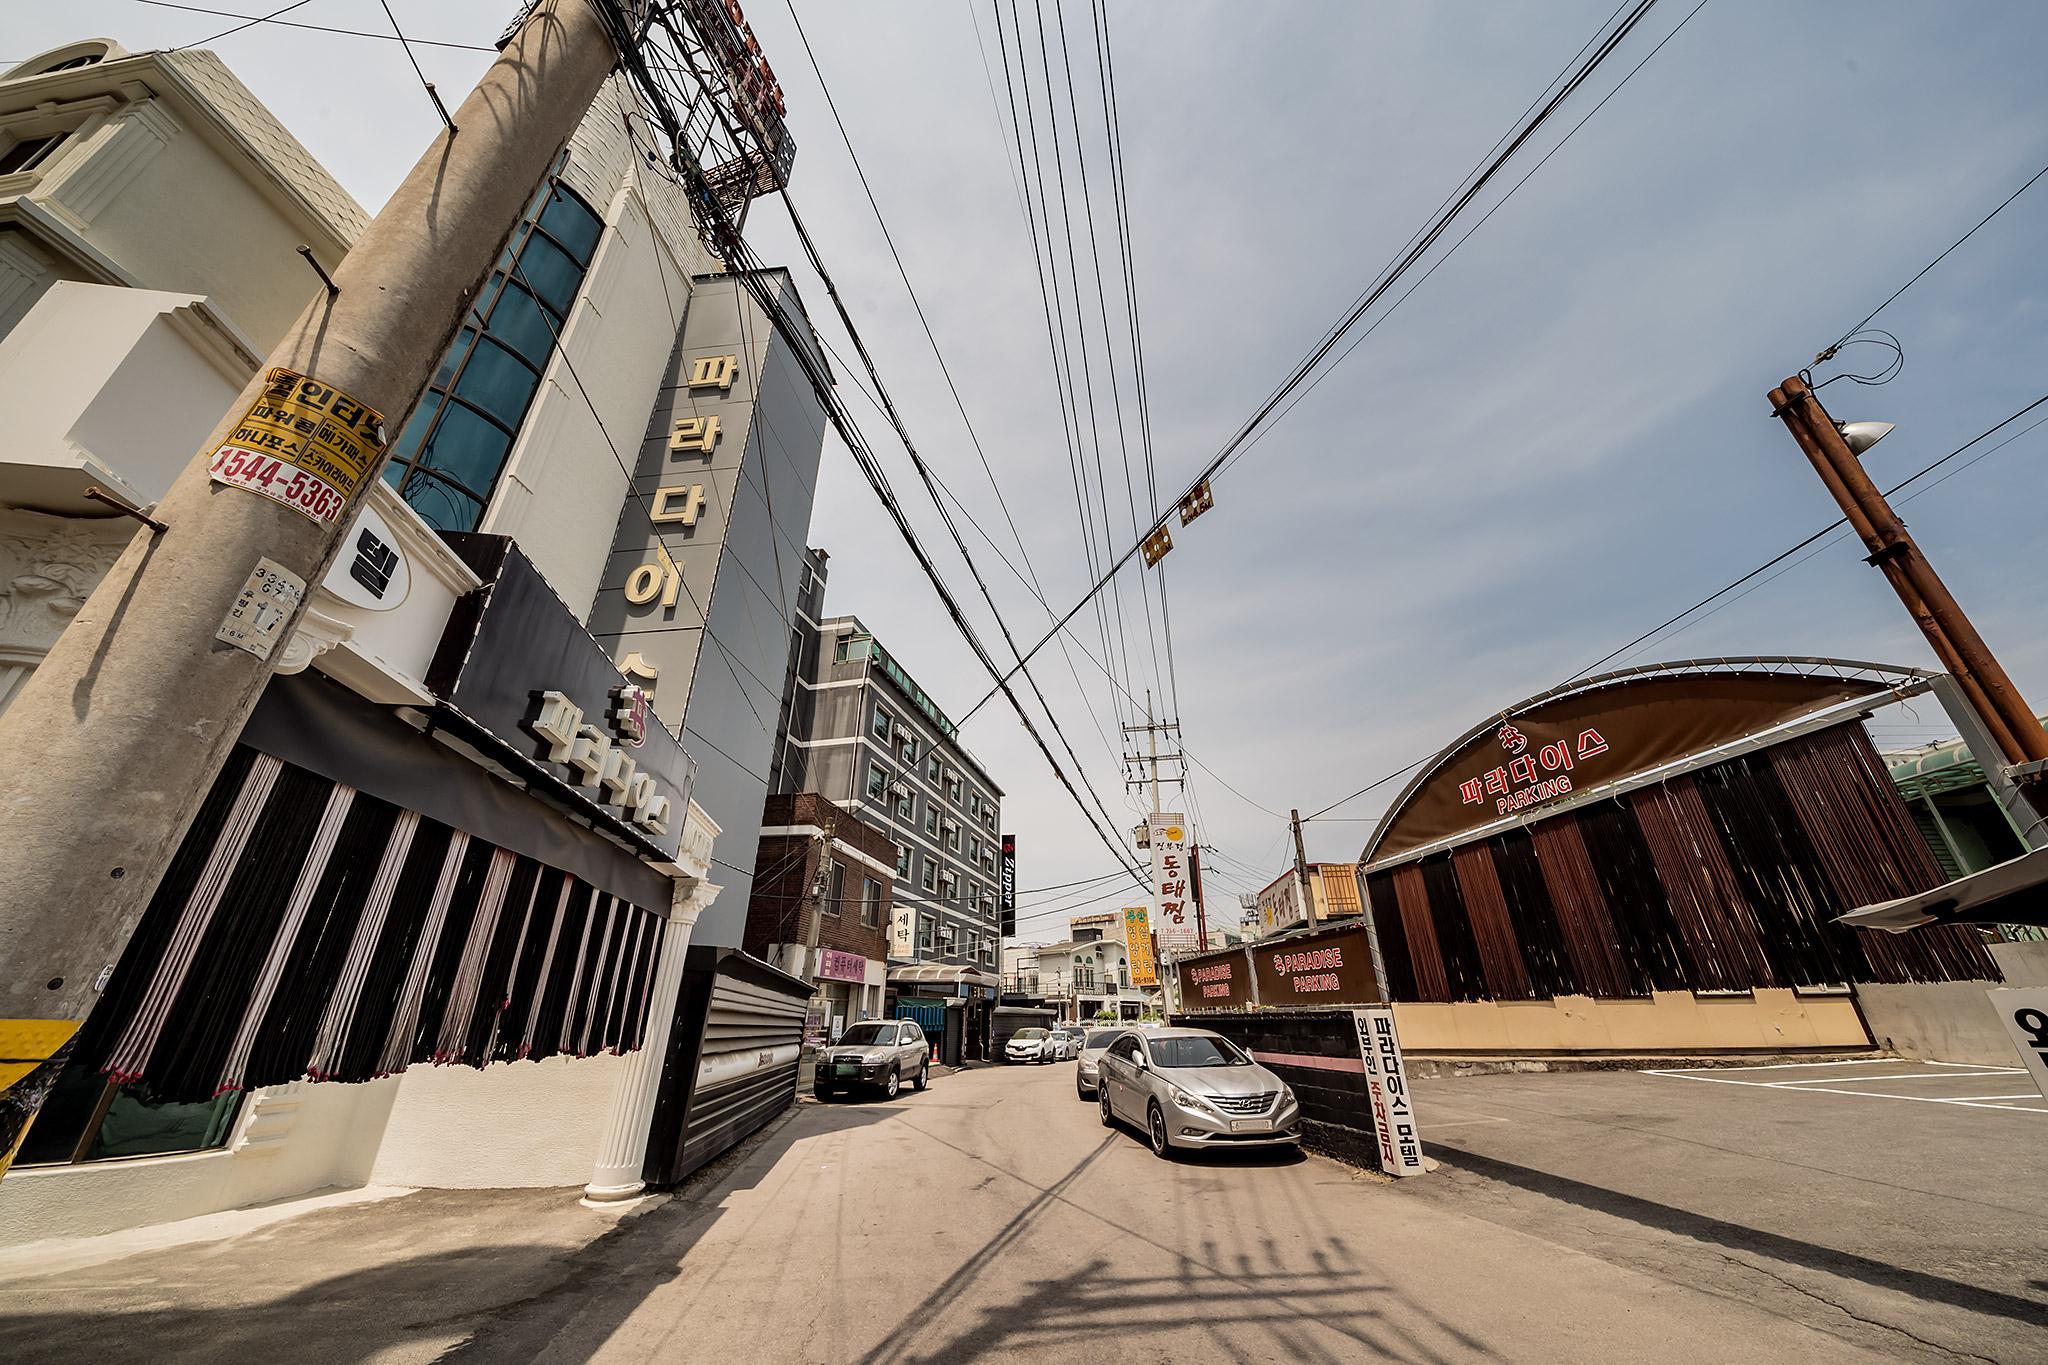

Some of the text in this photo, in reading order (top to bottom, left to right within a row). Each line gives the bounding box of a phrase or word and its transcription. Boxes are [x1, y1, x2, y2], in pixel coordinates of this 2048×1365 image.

[234, 428, 300, 457] 하나포스
[318, 429, 369, 469] 메가패스
[210, 449, 343, 521] 1544-5363
[304, 447, 354, 493] 스카이라이프
[350, 527, 400, 600] 텔
[1459, 728, 1609, 805] 파라다이스
[1496, 774, 1573, 815] PARKING
[1002, 857, 1015, 908] Zipper
[1161, 855, 1186, 925] 동태찜
[897, 912, 909, 942] 세탁
[1198, 963, 1233, 983] PARADISE
[1285, 947, 1344, 973] PARADISE
[1202, 982, 1230, 998] PARKING
[1293, 972, 1340, 993] PARKING
[1357, 1017, 1395, 1166] 외부인 주차금지
[1373, 1016, 1420, 1168] 파라다이스 모텔
